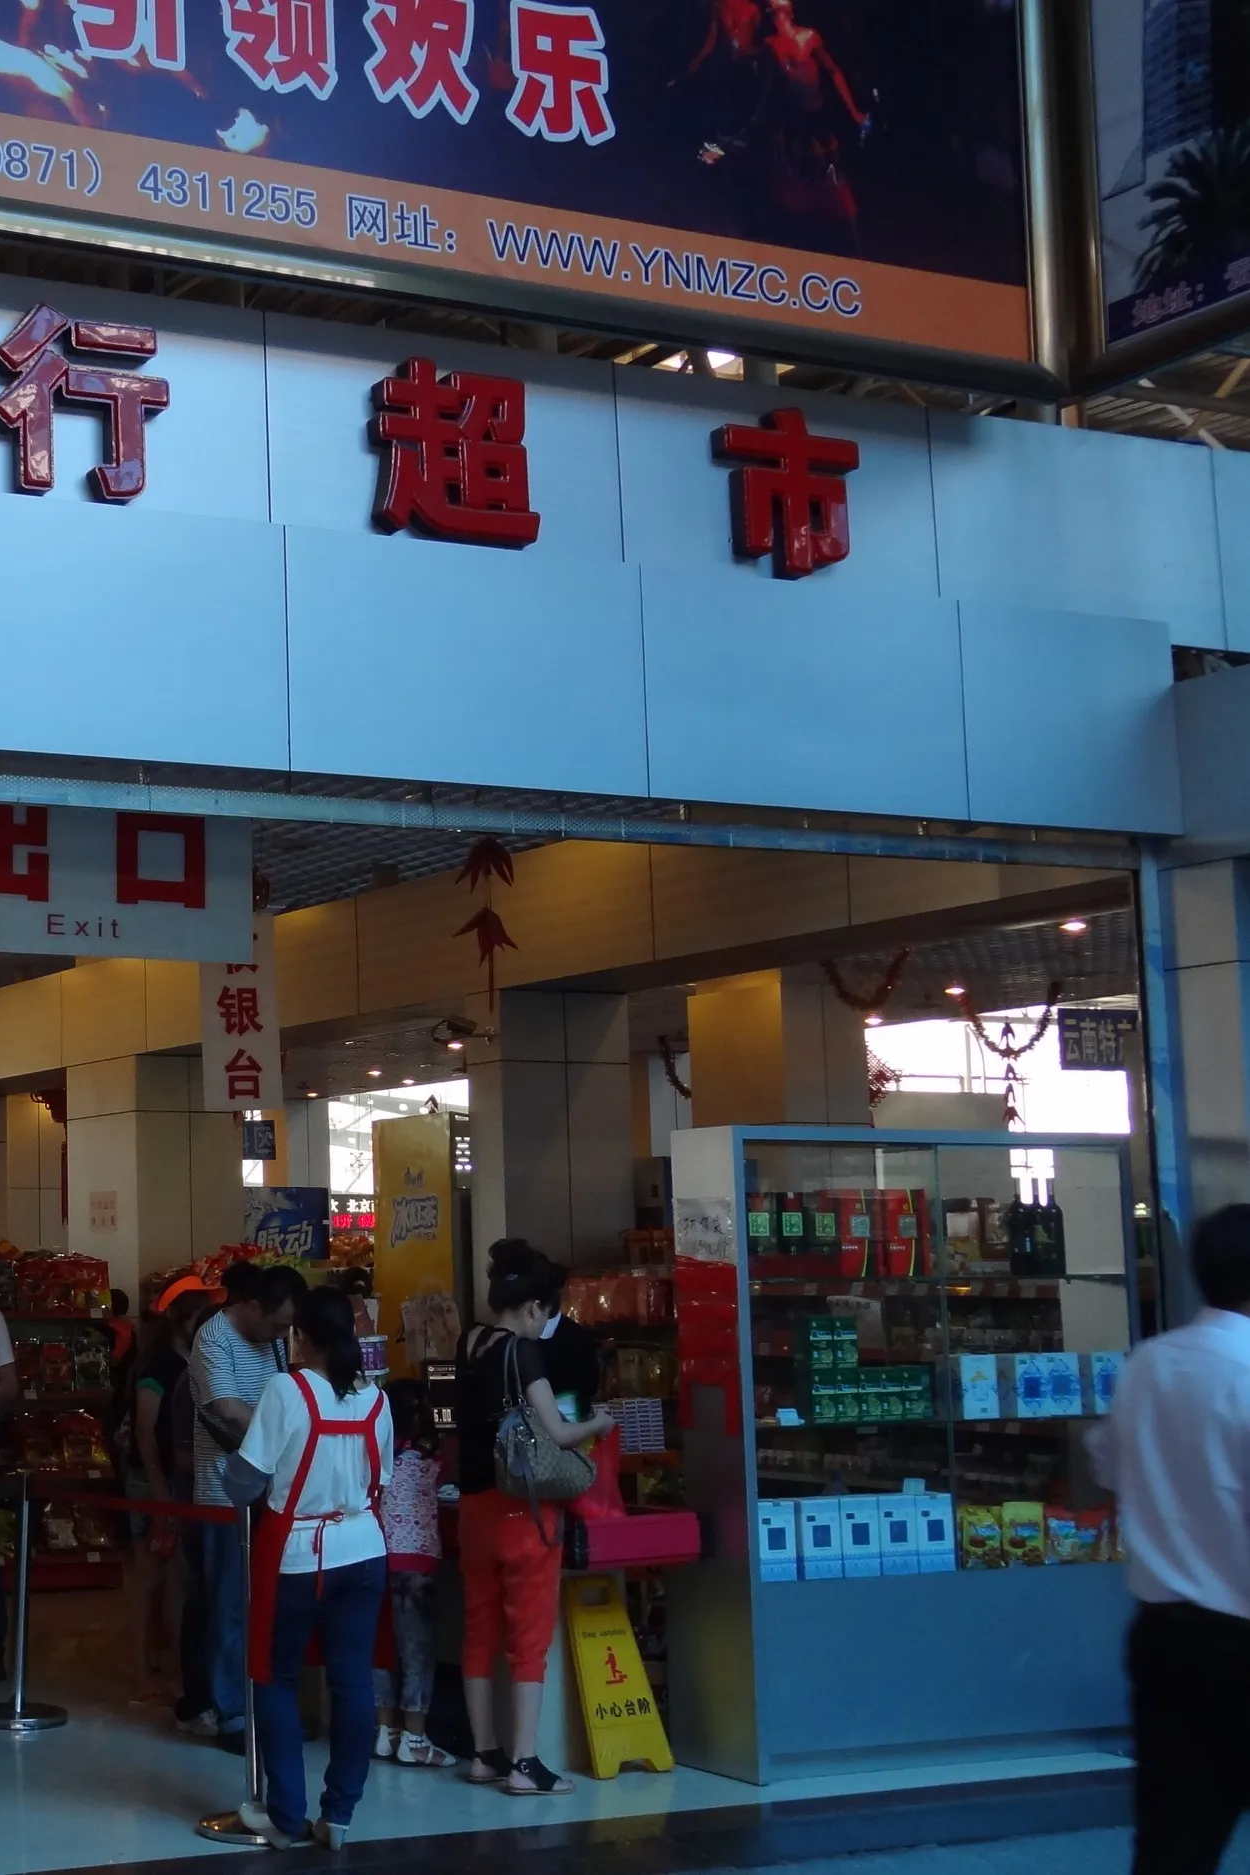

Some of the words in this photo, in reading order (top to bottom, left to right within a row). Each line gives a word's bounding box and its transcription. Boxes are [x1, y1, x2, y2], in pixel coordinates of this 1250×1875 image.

[138, 164, 319, 229] 4311255
[486, 218, 862, 318] WWW.YNMZC.CC
[46, 913, 121, 939] Exit
[217, 963, 264, 1101] 银台
[595, 1697, 652, 1721] 小心台阶
